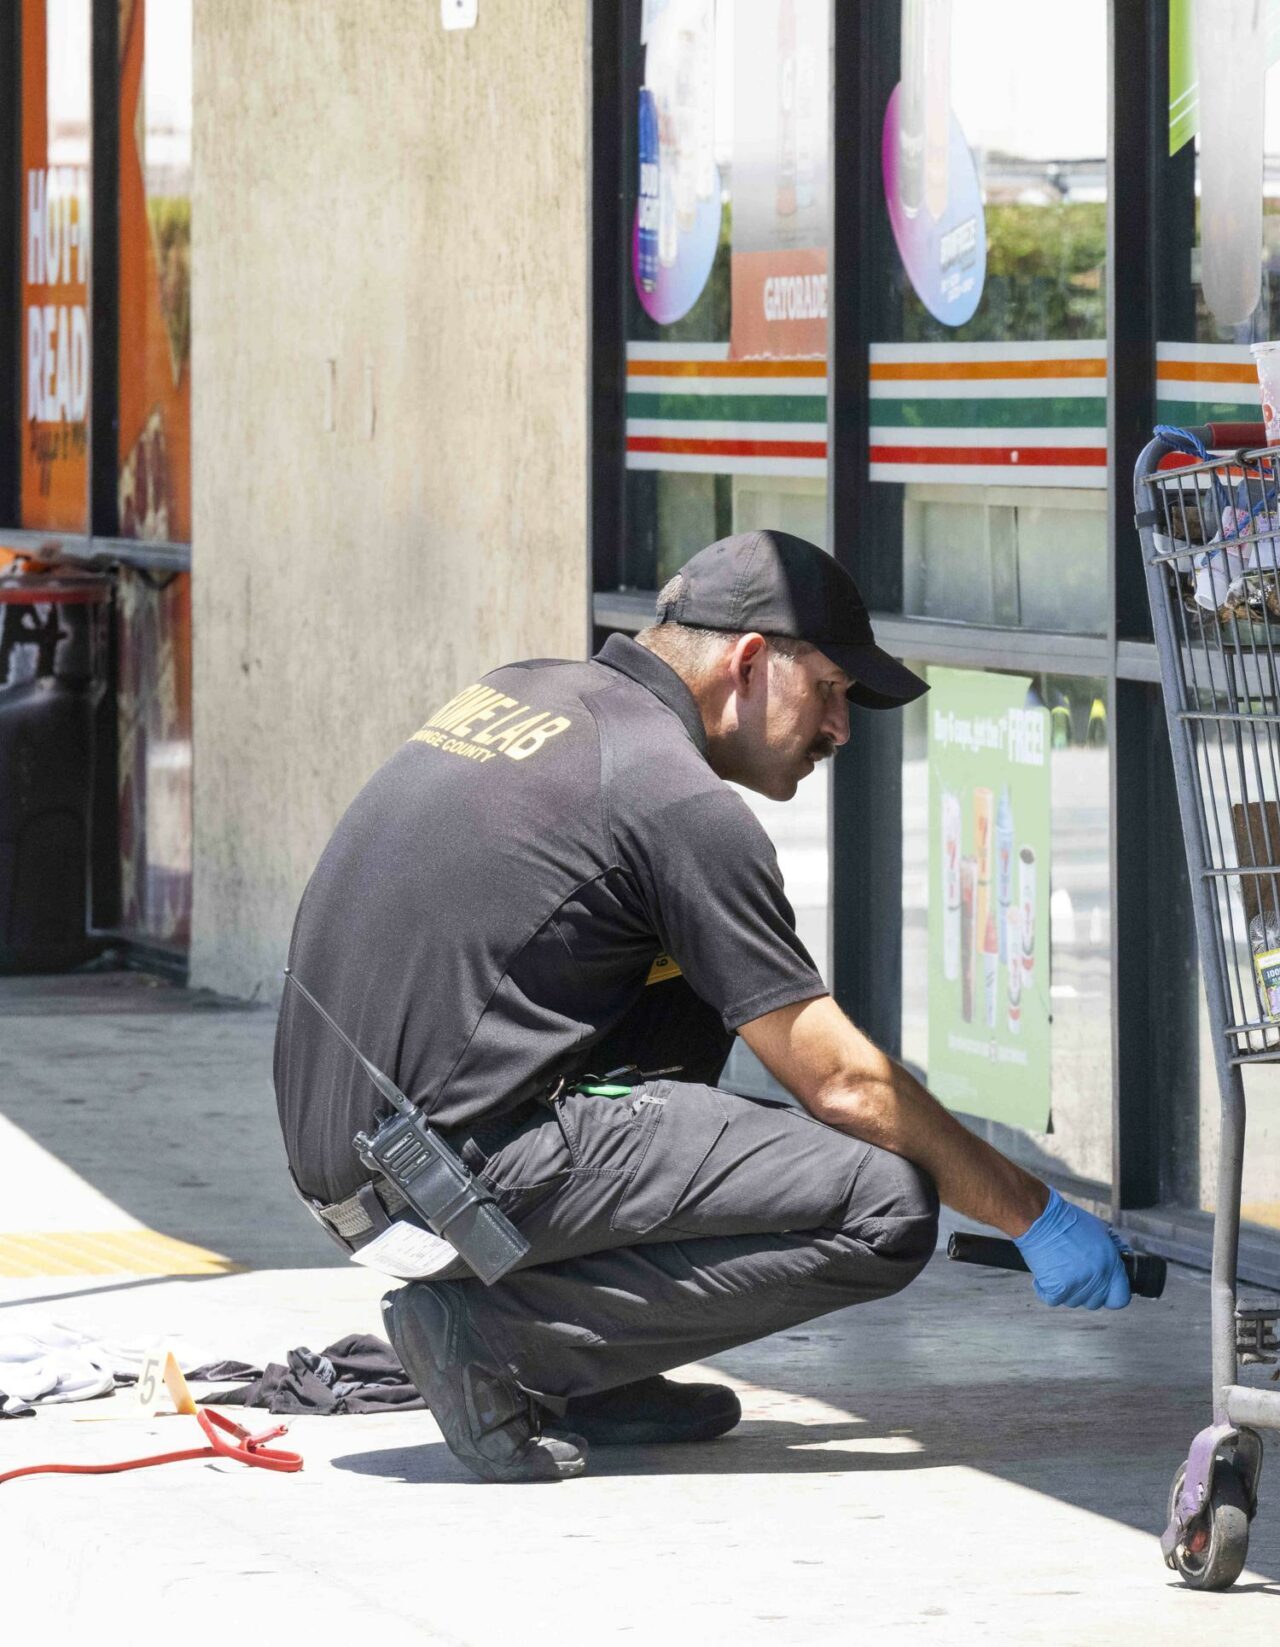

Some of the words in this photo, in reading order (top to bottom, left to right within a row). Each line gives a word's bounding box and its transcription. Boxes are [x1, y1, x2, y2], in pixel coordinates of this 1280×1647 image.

[441, 739, 496, 763] COUNTY
[471, 706, 571, 760] LAB
[140, 1359, 159, 1405] 5
